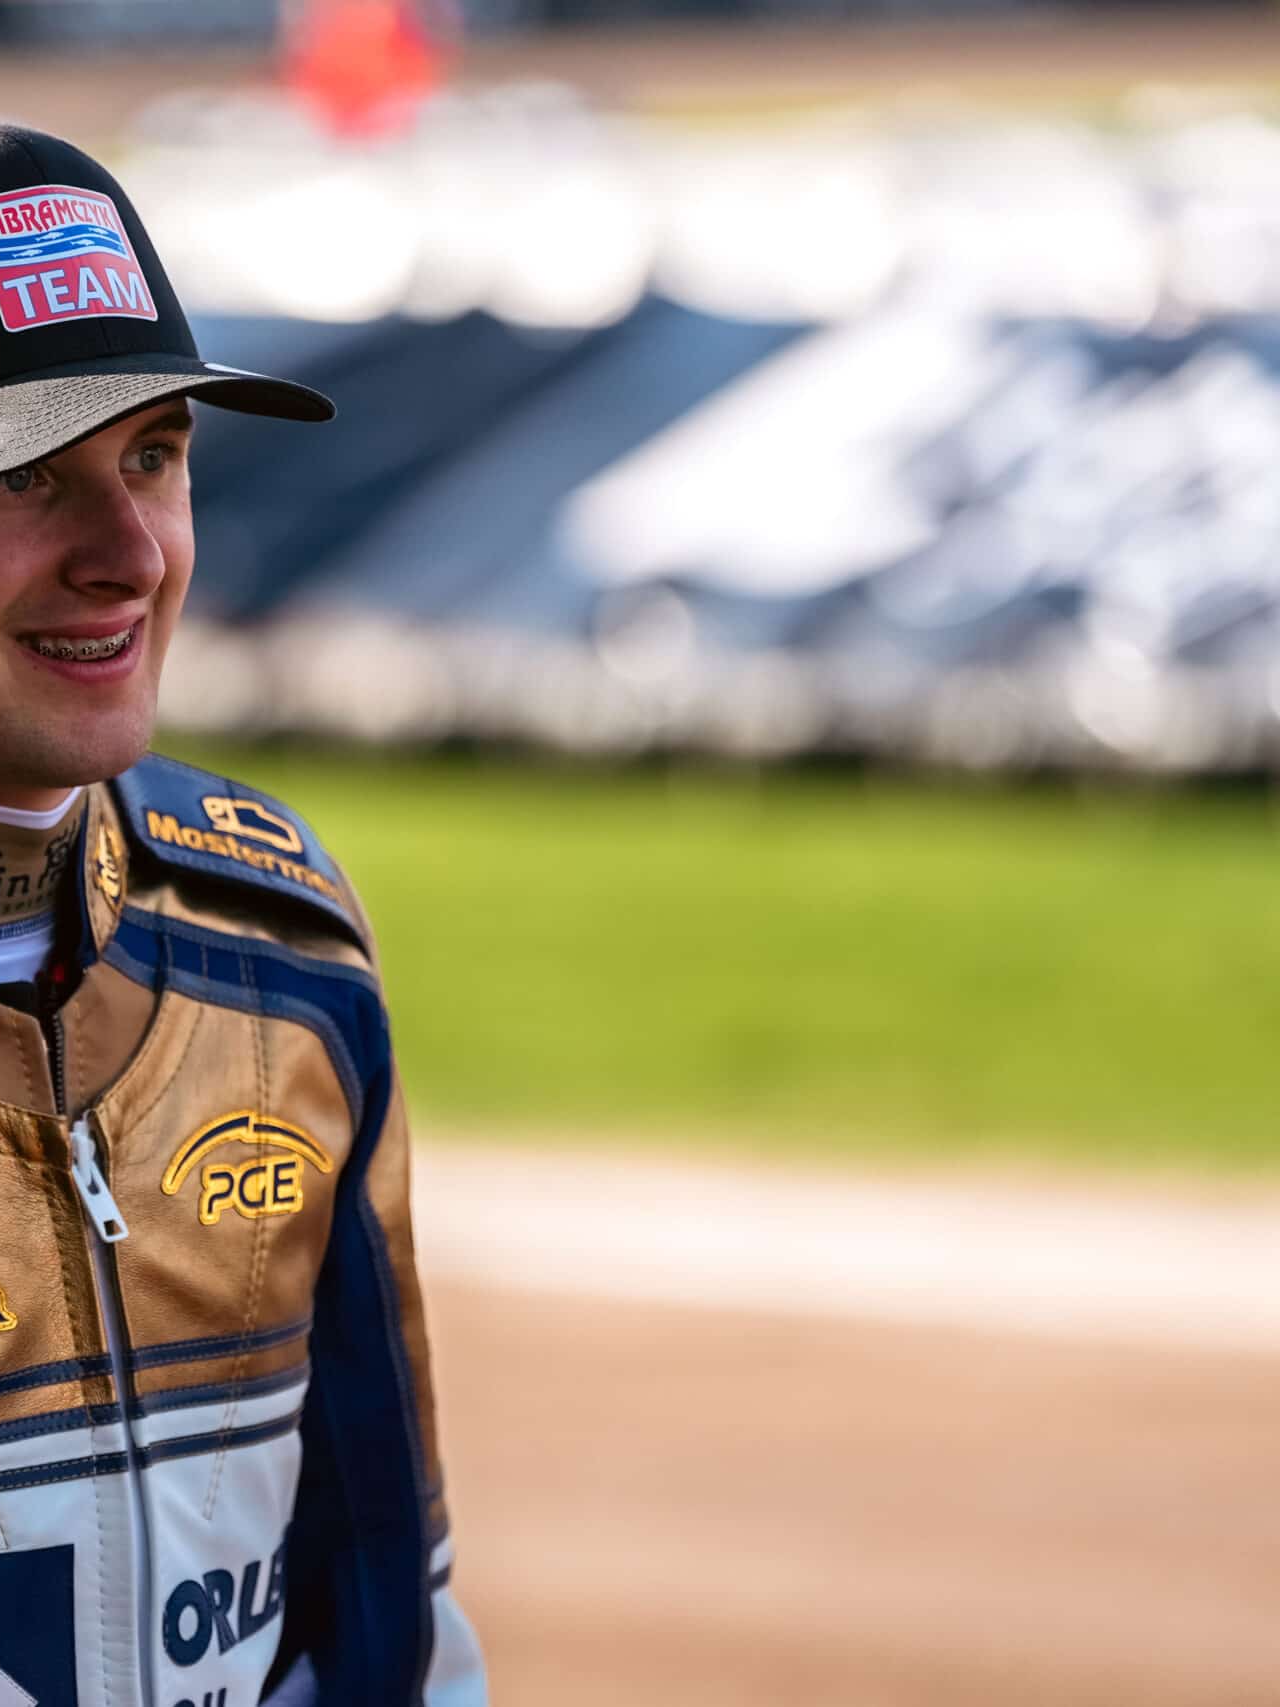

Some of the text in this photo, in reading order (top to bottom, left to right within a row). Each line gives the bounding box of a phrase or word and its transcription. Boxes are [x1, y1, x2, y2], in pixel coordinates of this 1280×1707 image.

[1, 265, 151, 320] TEAM
[208, 1161, 297, 1215] PGE
[162, 1548, 287, 1668] ORLE
